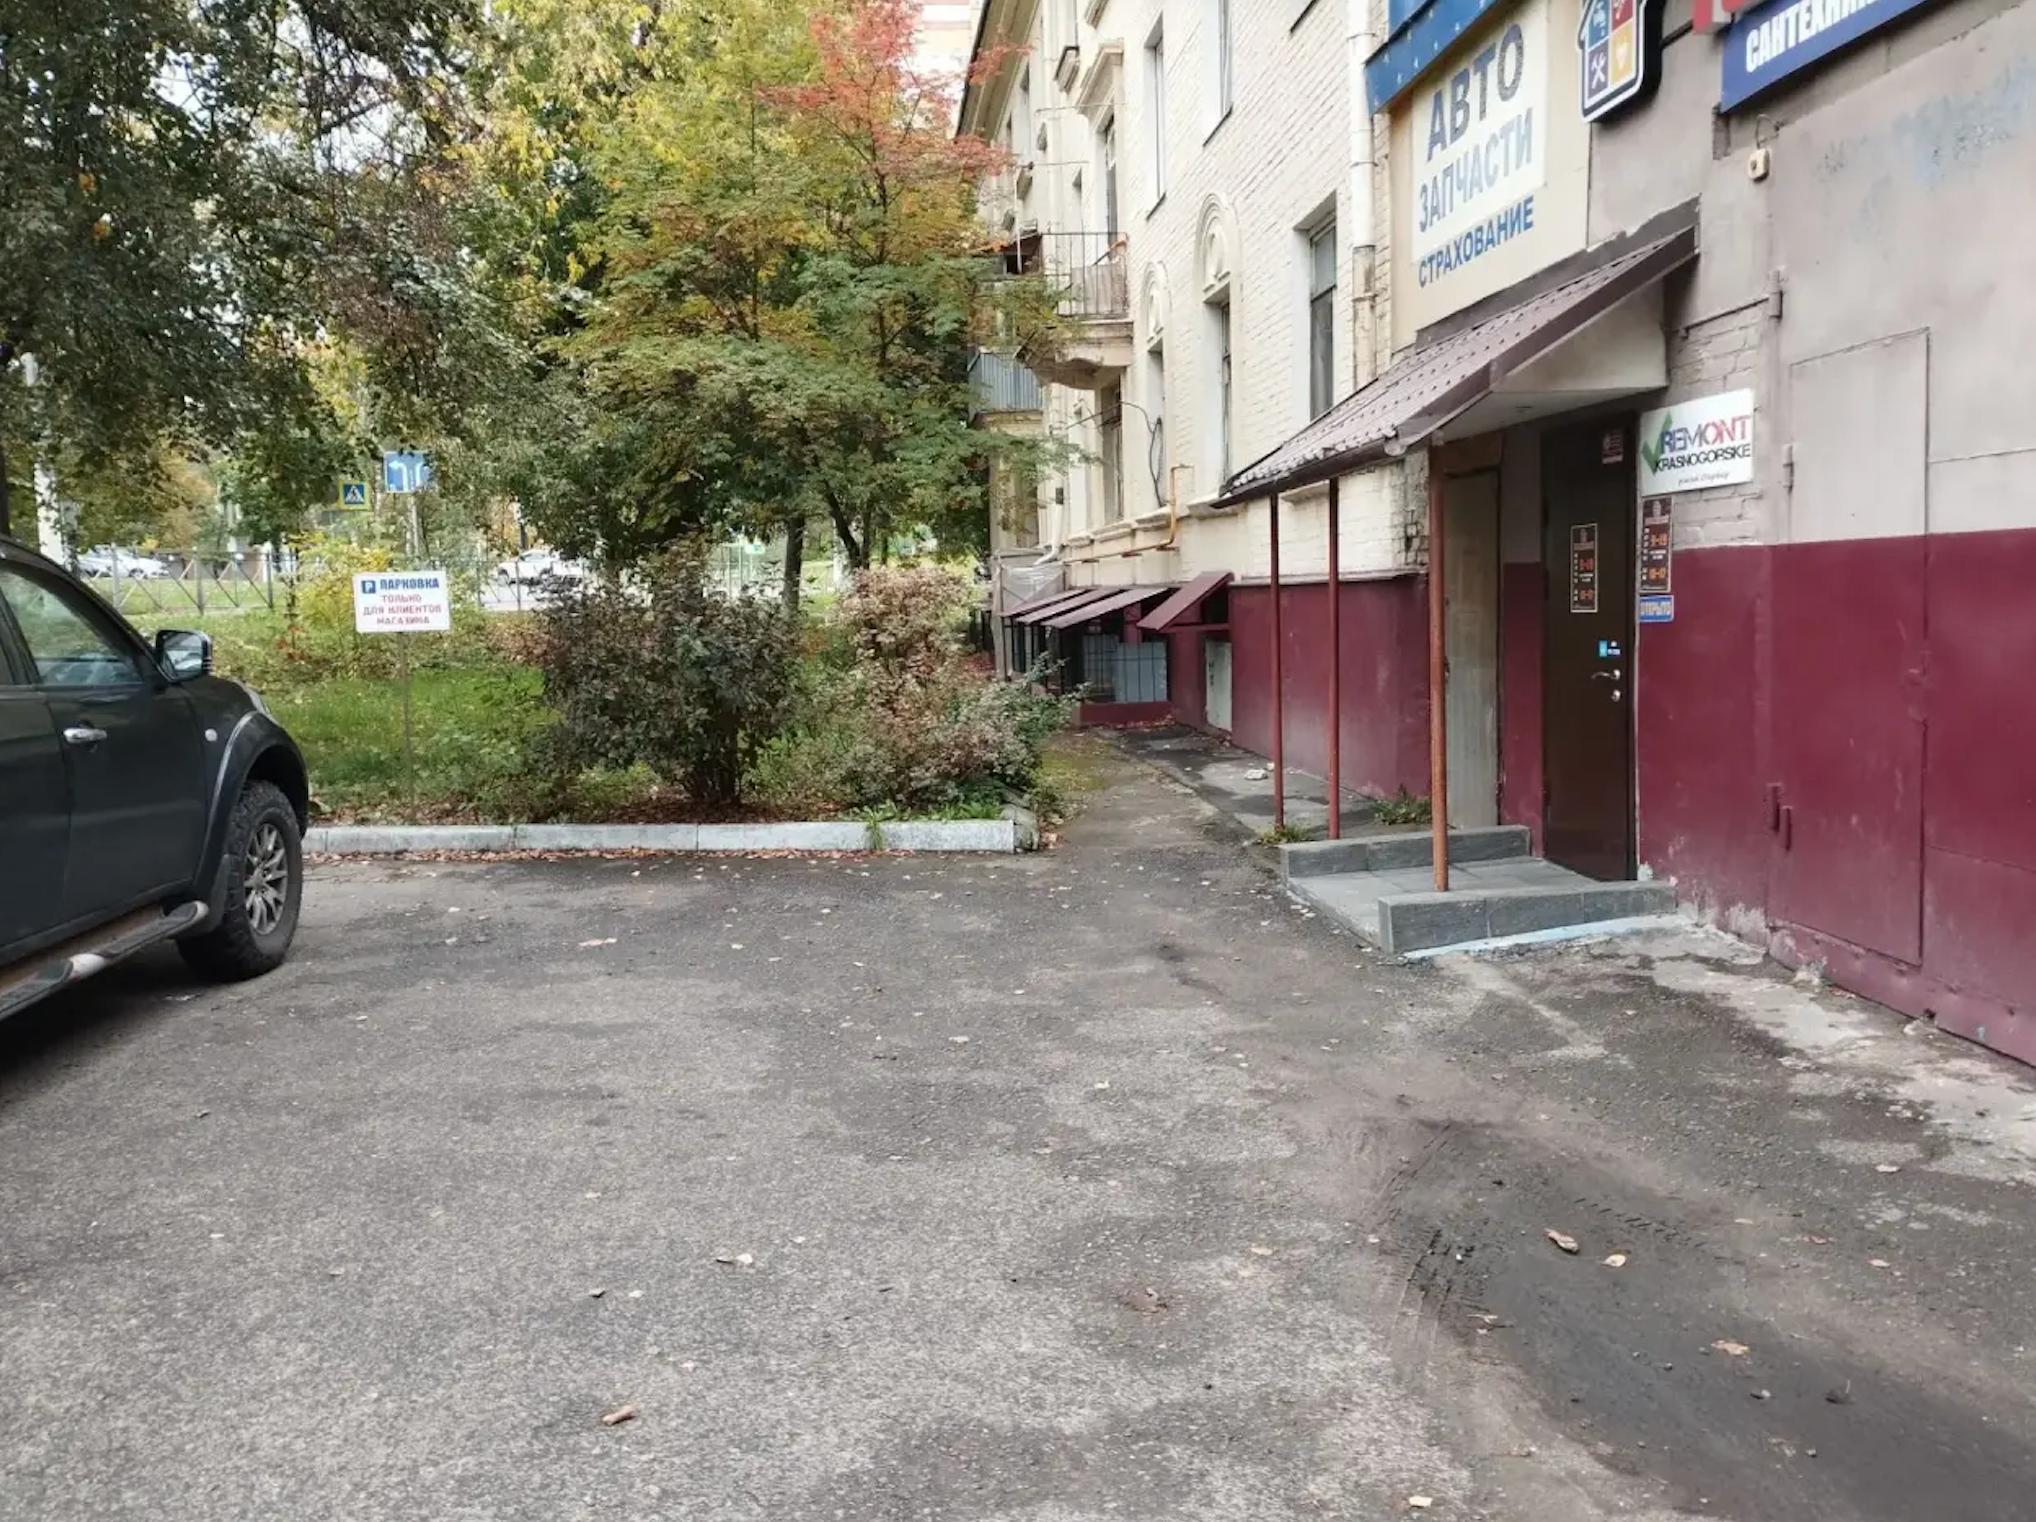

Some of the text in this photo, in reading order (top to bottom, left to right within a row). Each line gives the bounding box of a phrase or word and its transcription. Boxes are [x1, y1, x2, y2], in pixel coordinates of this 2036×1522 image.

[1427, 23, 1524, 162] АВТО
[1419, 107, 1533, 223] ЗАПЧАСТИ
[1418, 196, 1535, 288] СТРАХОВАНИЕ
[1660, 414, 1751, 455] REMONT
[380, 578, 440, 590] ПАРКОВКА
[363, 604, 442, 616] ДЛЯ КЛИЕНТОВ
[382, 594, 422, 603] ТОЛЬКО
[377, 616, 430, 625] МАГАЗИНА
